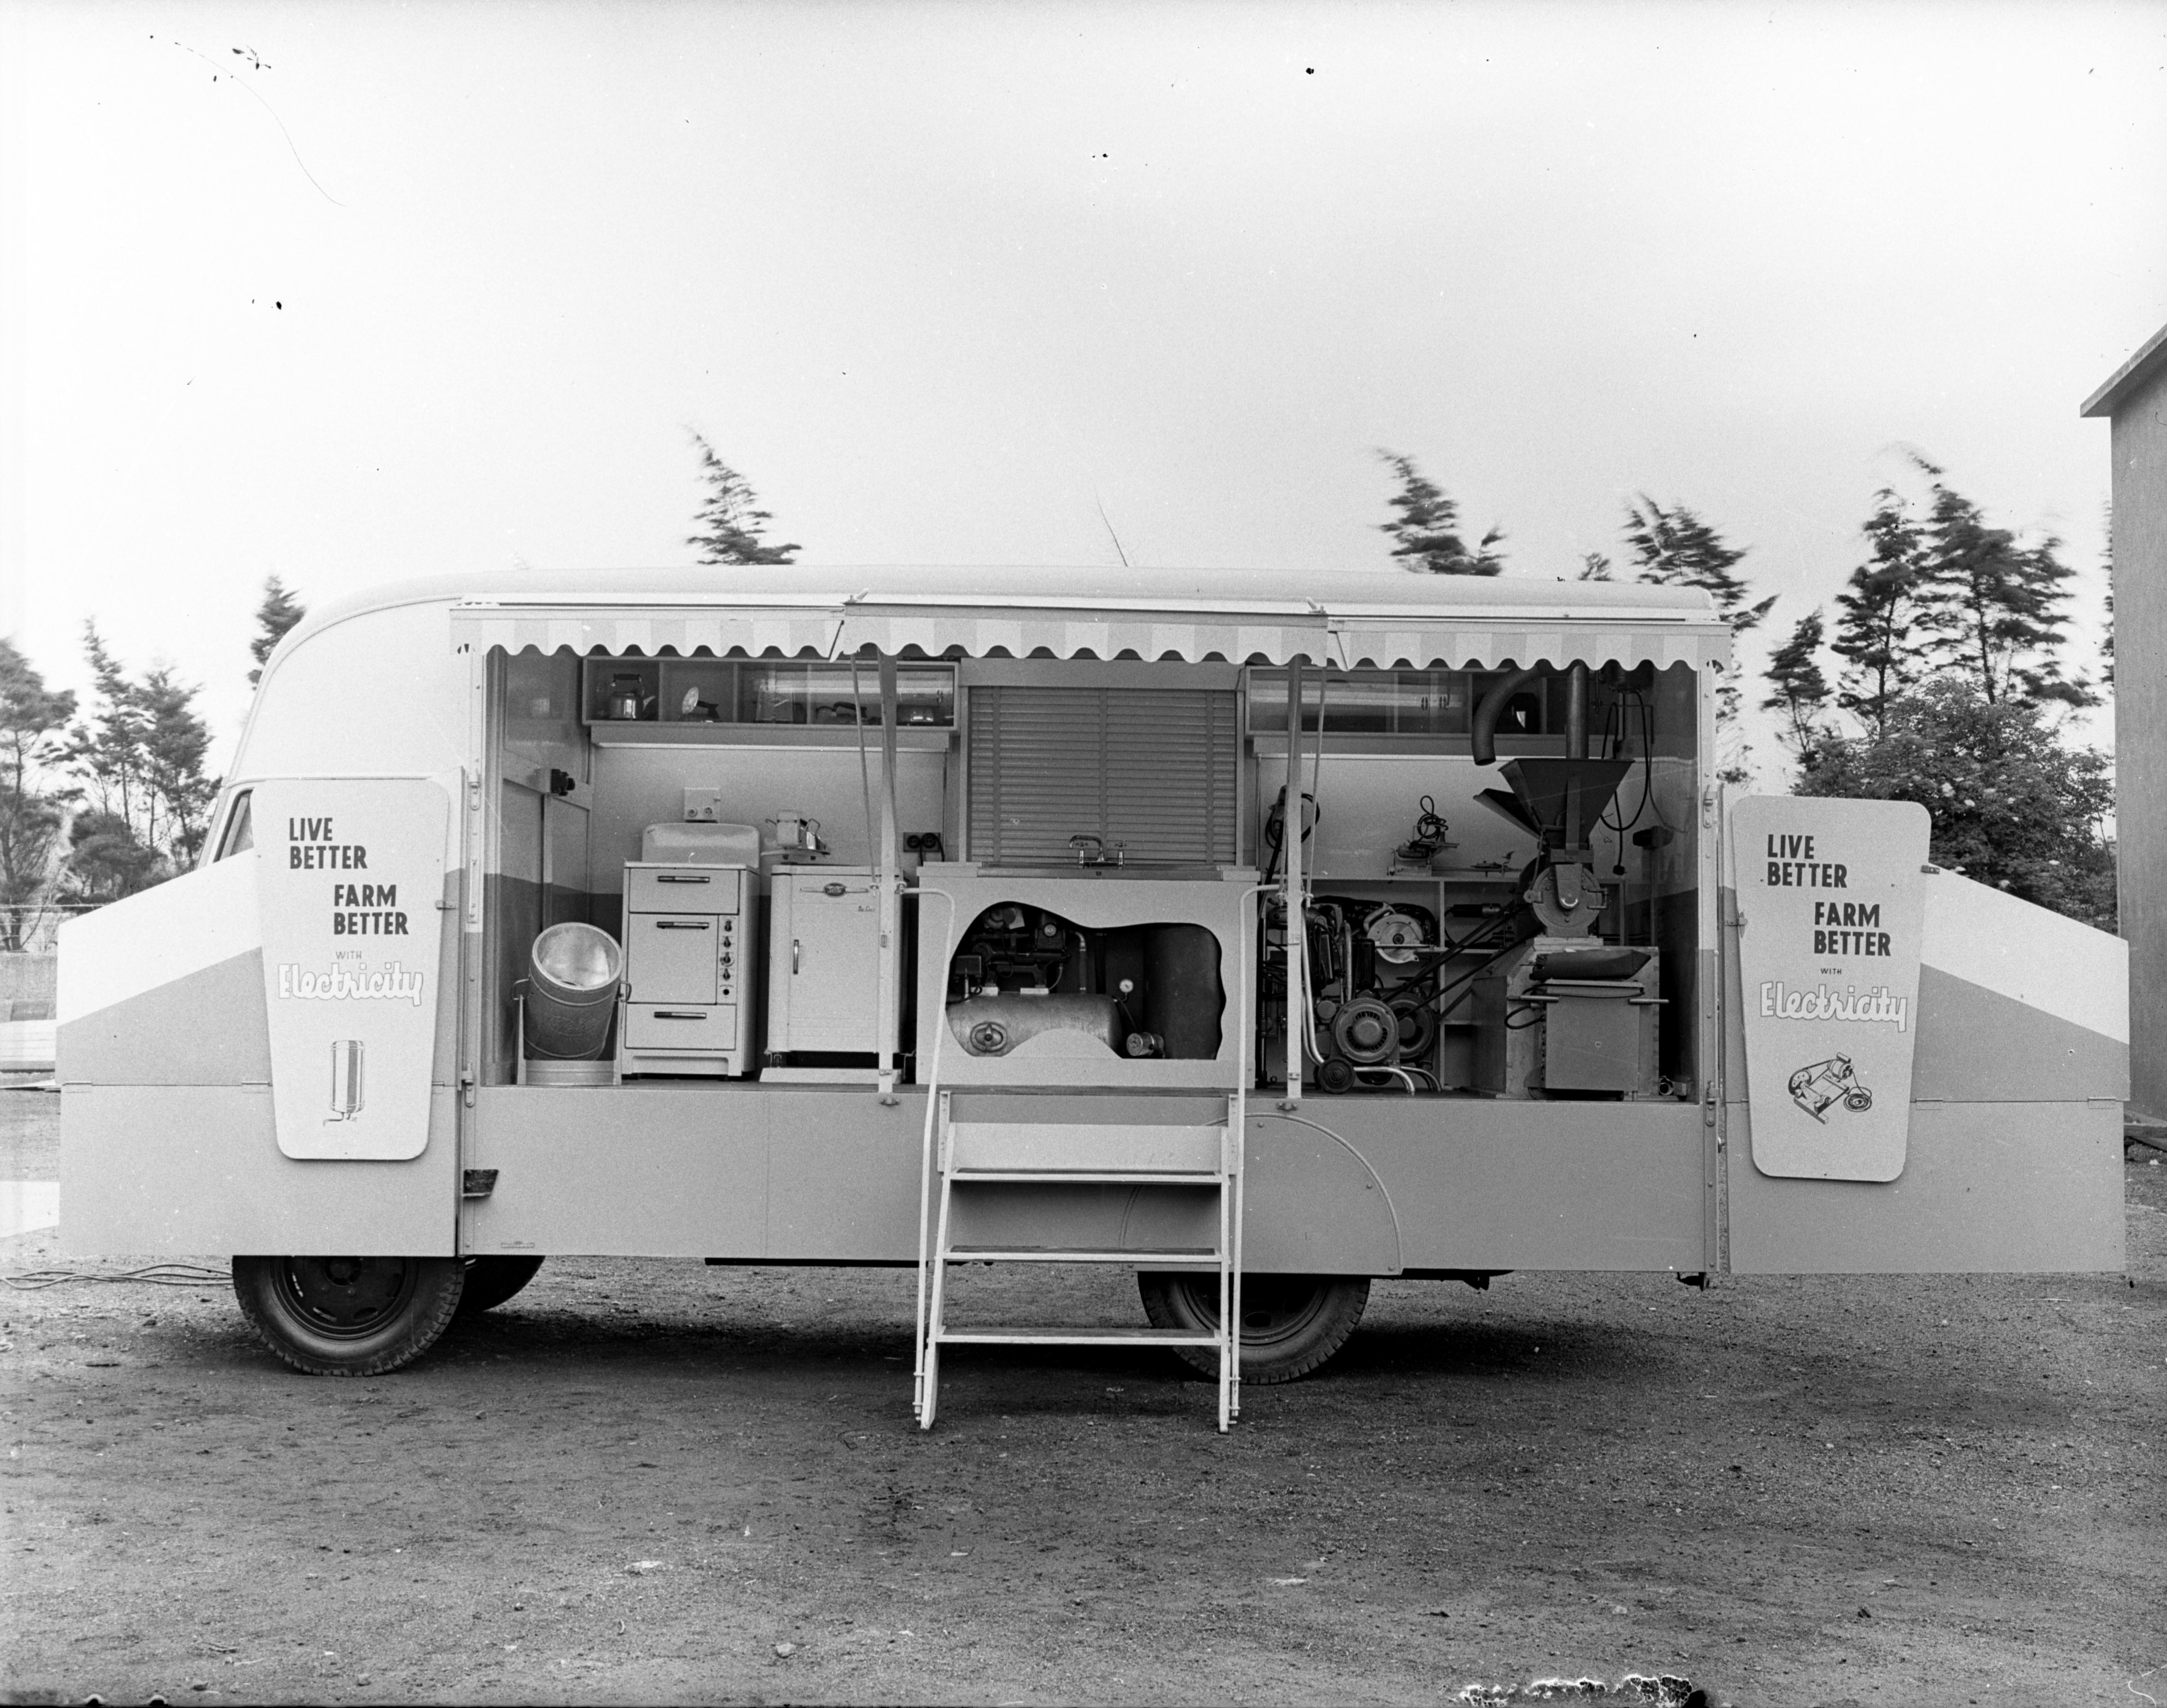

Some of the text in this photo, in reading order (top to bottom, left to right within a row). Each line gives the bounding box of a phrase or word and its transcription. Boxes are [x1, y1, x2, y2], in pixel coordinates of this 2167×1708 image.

[289, 818, 333, 841] LIVE
[290, 846, 367, 869] BETTER
[1767, 834, 1814, 860] LIVE
[1767, 862, 1848, 889] BETTER
[334, 884, 397, 907] FARM
[334, 912, 409, 935] BETTER
[1814, 902, 1880, 928] FARM
[336, 950, 362, 960] WITH
[1814, 930, 1891, 957] BETTER
[278, 961, 423, 1006] Electricity
[1760, 981, 1908, 1033] Electricity
